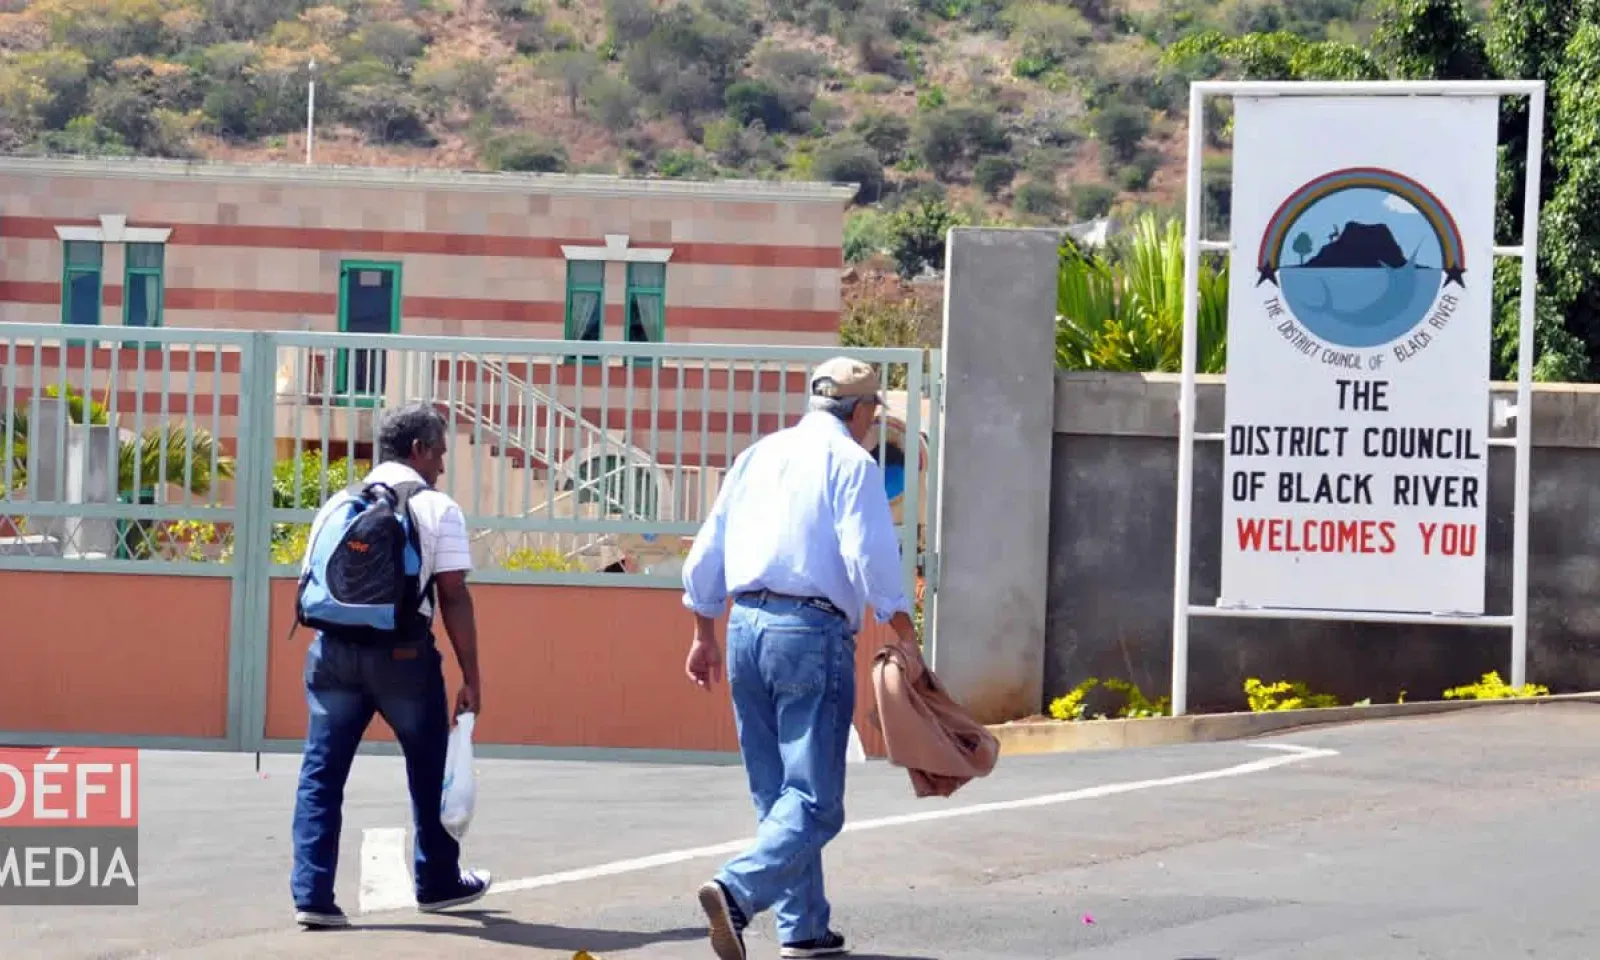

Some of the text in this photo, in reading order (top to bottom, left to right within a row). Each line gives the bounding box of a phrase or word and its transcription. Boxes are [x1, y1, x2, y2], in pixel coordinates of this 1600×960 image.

[1264, 294, 1458, 371] THE DISTRICT COUNCIL OF BLACK RIVER
[1336, 379, 1389, 412] THE
[1230, 425, 1481, 460] DISTRICT COUNCIL
[1232, 471, 1479, 508] OF BLACK RIVER
[1236, 517, 1477, 557] WELCOMES YOU
